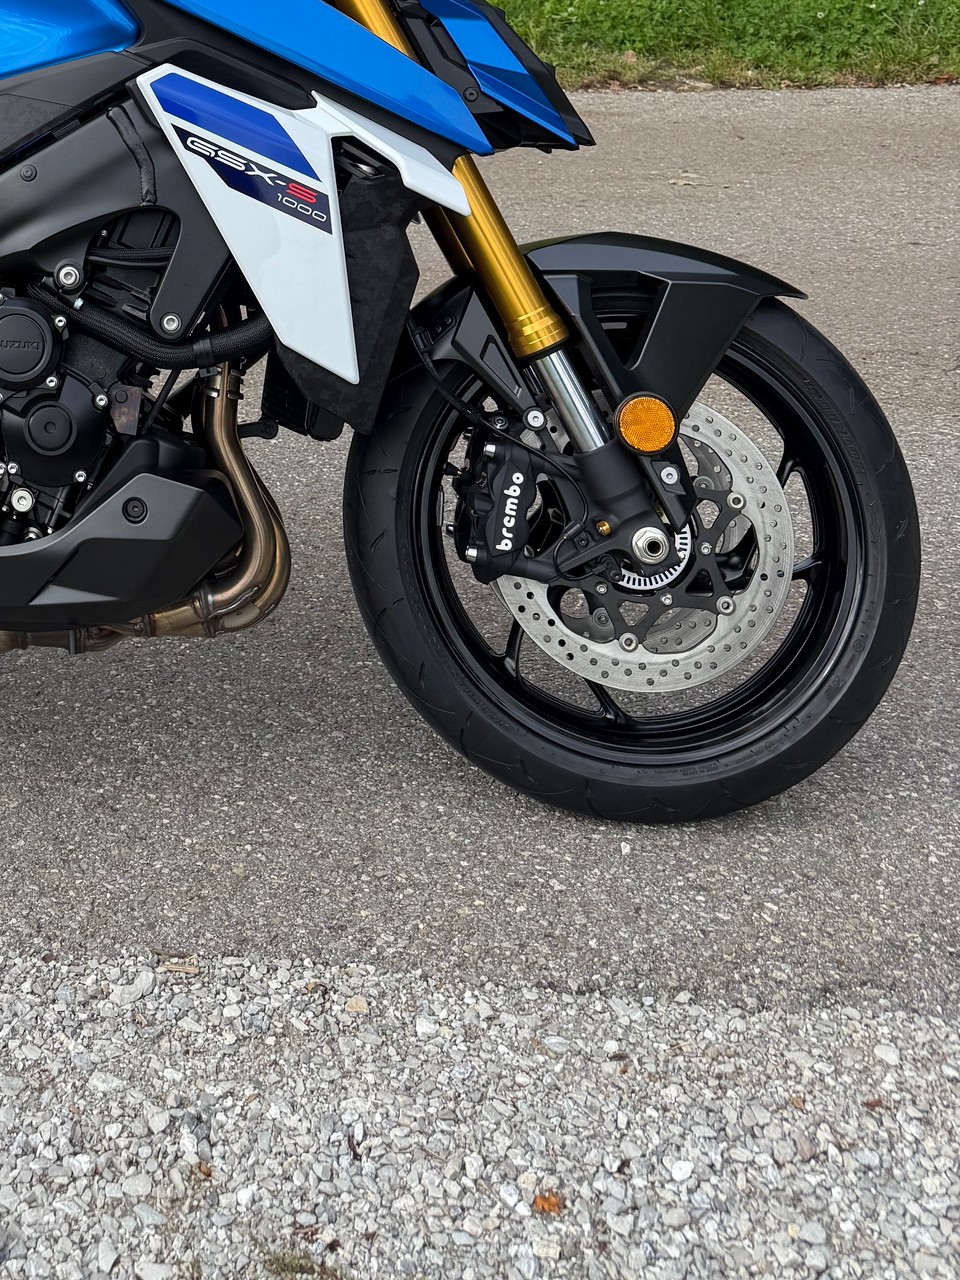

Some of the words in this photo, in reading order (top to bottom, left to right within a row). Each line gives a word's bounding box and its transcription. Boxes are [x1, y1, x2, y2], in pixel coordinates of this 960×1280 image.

[186, 136, 318, 204] GSX-S
[277, 192, 328, 222] 1000
[495, 472, 524, 551] brembo
